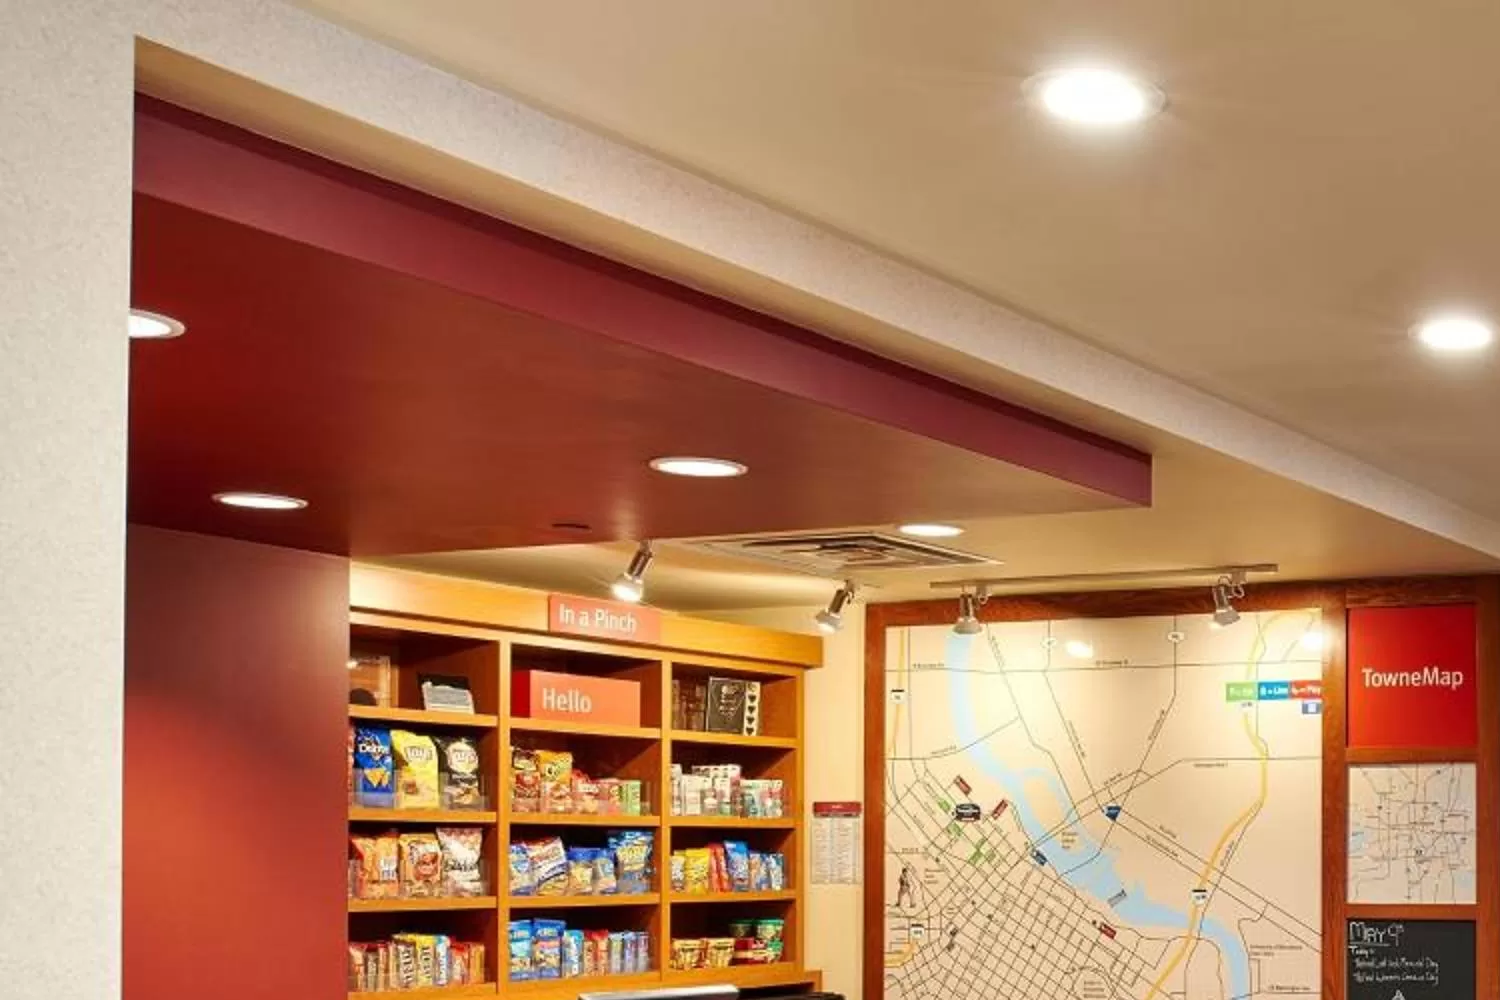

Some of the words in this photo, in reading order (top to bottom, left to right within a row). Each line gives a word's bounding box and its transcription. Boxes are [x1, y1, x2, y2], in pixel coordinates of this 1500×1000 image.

[559, 603, 575, 625] In
[579, 610, 589, 627] a
[595, 607, 637, 634] Pinch
[1362, 666, 1464, 690] TowneMap
[543, 687, 593, 713] Hello
